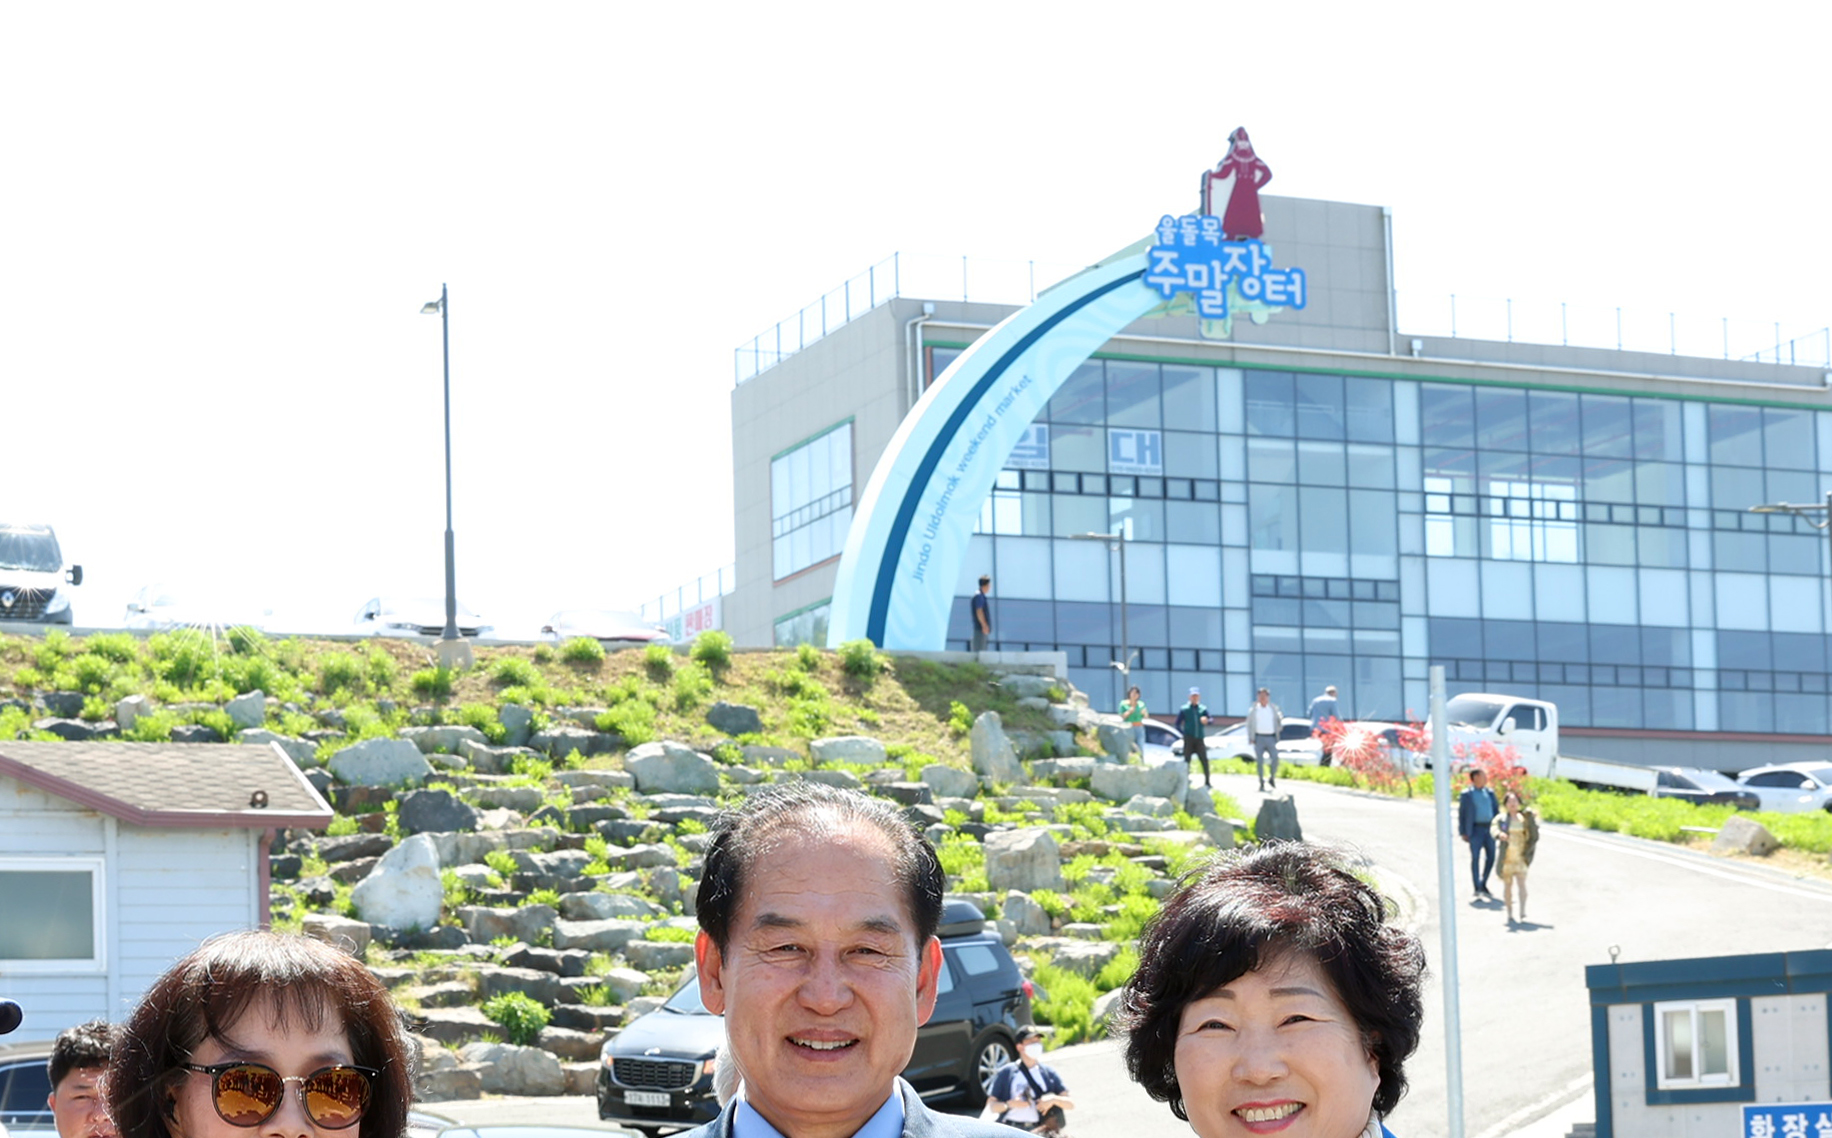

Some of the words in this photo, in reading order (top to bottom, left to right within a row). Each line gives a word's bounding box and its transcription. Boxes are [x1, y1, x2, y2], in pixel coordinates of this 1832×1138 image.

[1157, 217, 1221, 246] 울돌목
[1147, 244, 1303, 315] 주말장터
[1110, 429, 1160, 465] 대
[912, 537, 933, 584] Jindo
[956, 415, 997, 474] weekend
[994, 375, 1032, 417] market
